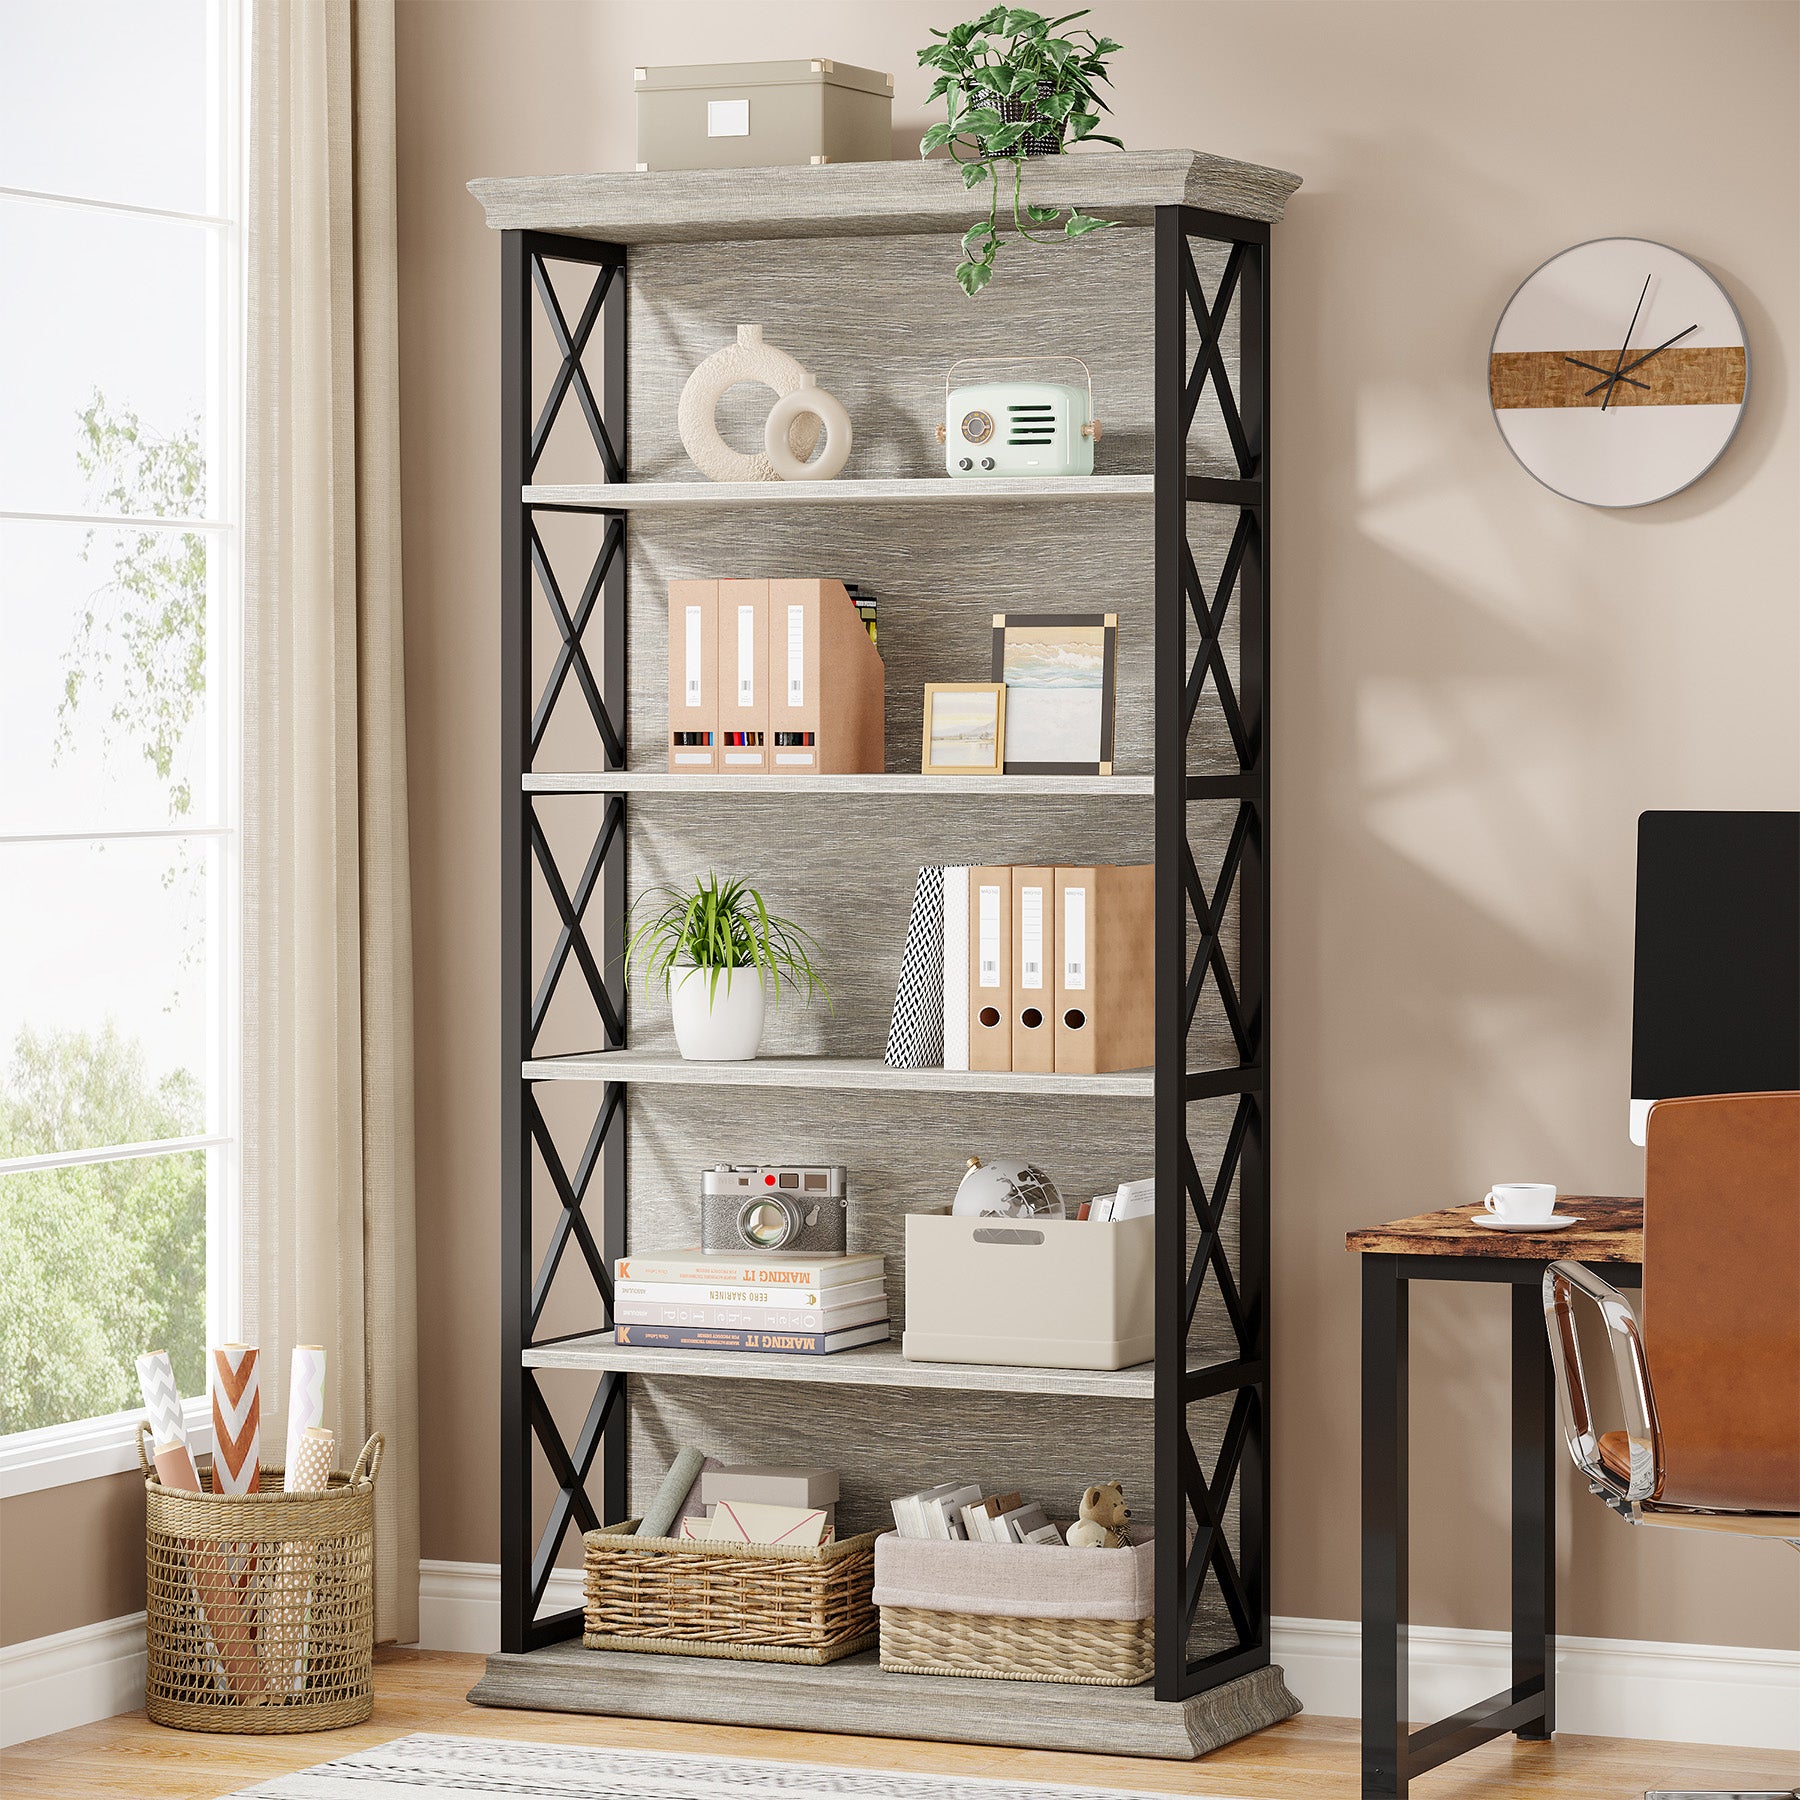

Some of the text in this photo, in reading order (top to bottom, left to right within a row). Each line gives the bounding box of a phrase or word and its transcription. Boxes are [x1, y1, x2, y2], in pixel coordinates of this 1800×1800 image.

[743, 1270, 811, 1284] MAKING IT
[709, 1291, 768, 1302] EERO SAARINEN
[745, 1335, 816, 1350] MAKING IT
